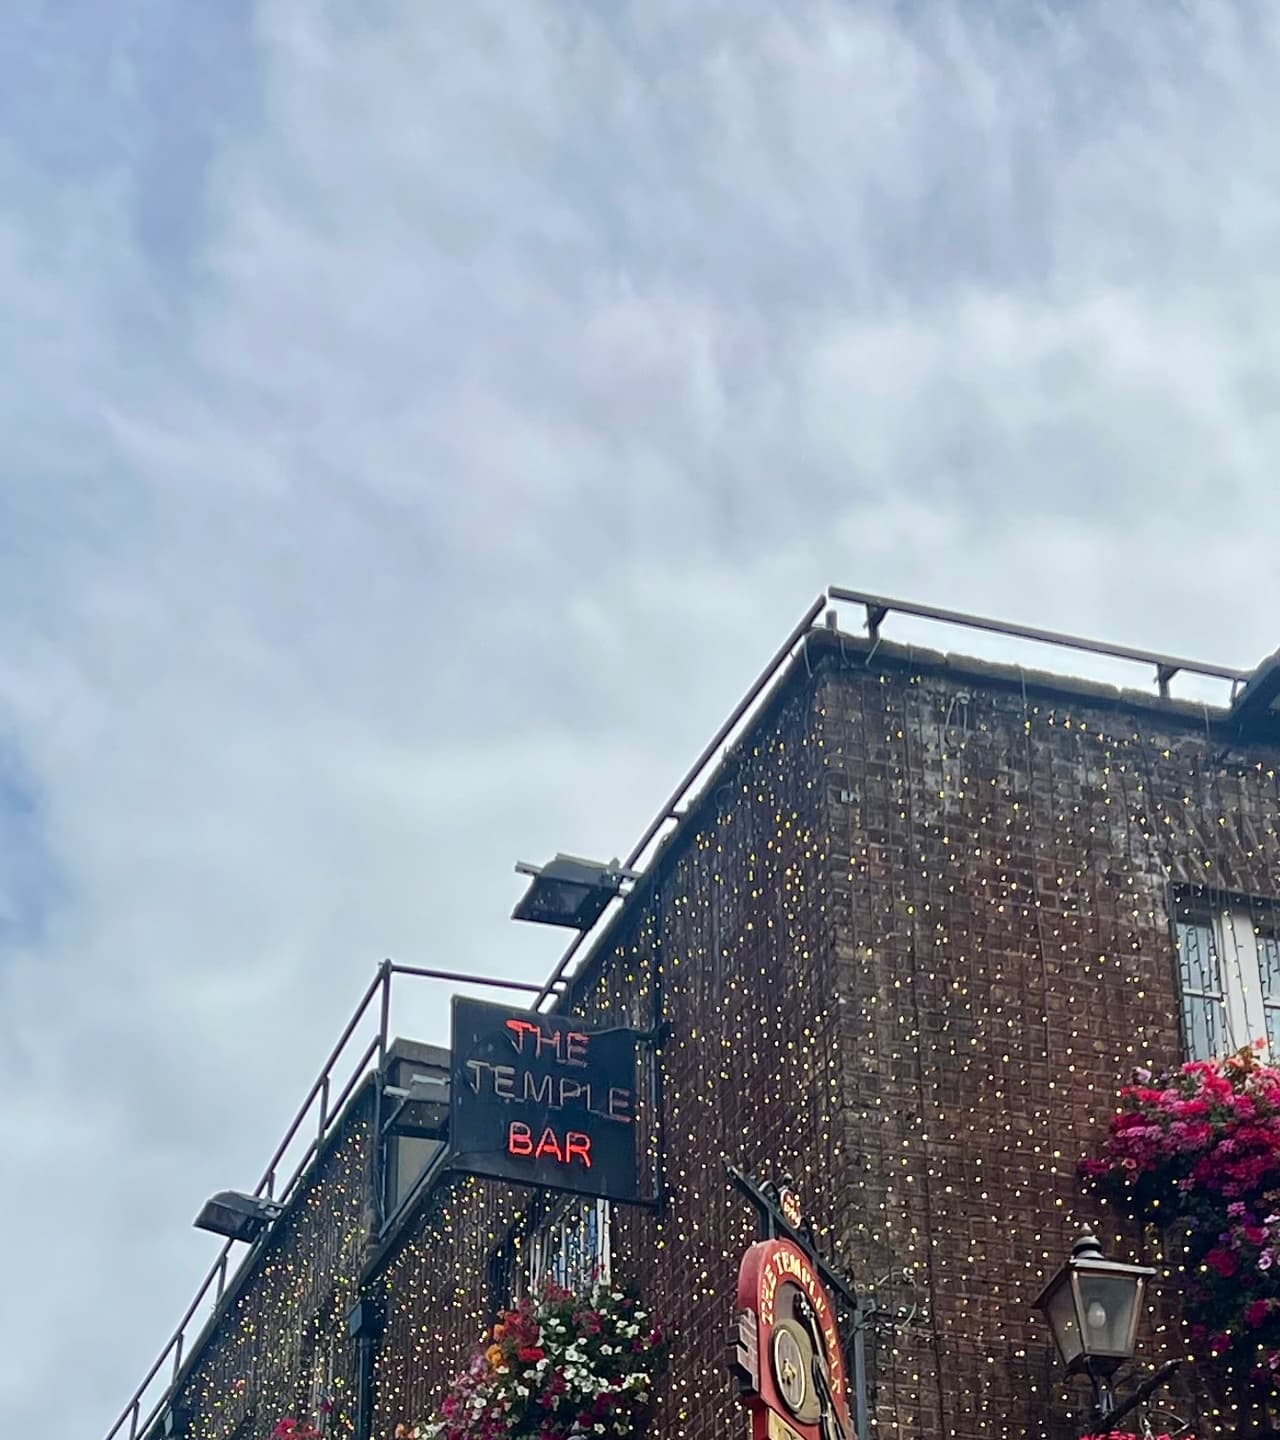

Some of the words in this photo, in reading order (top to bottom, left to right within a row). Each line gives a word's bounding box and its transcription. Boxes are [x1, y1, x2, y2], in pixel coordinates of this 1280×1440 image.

[506, 1019, 590, 1068] THE
[466, 1059, 632, 1123] TEMPLE
[508, 1121, 593, 1168] BAR
